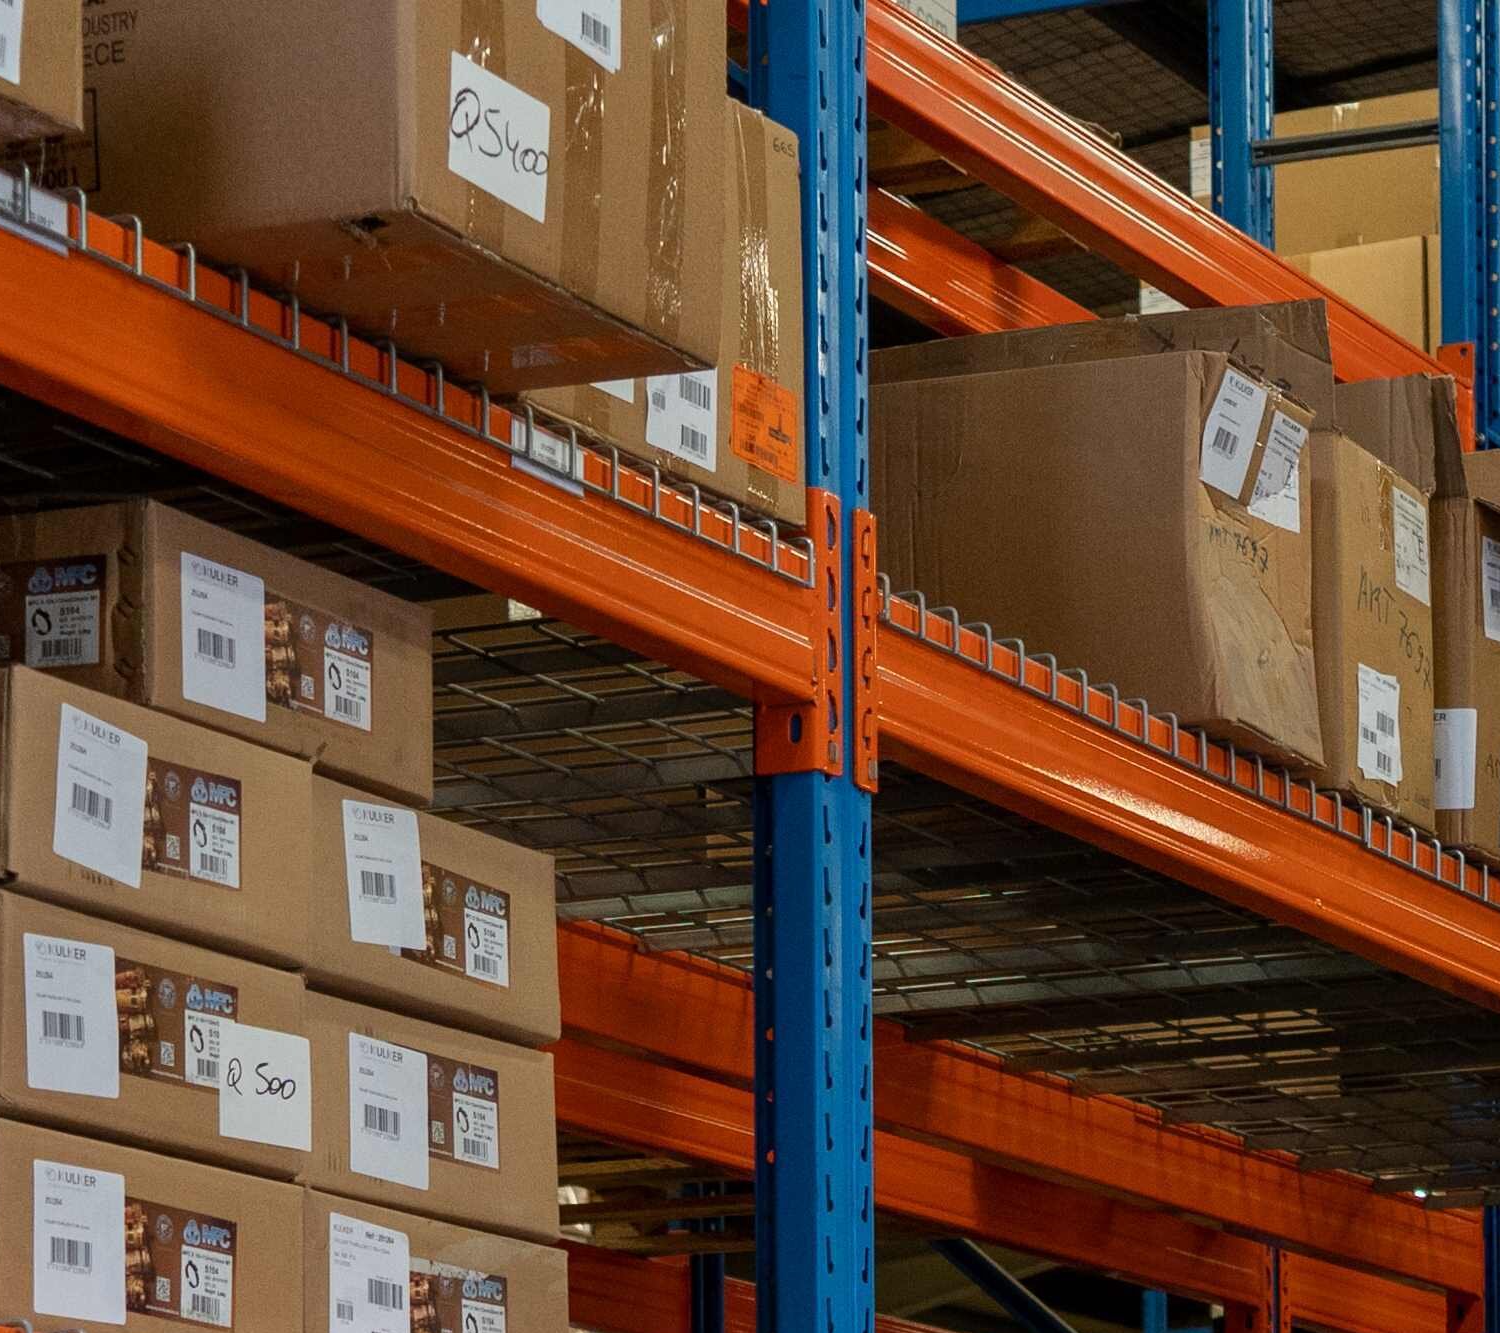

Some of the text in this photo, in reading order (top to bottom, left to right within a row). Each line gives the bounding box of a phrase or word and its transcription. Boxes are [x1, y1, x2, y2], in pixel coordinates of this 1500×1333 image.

[54, 564, 97, 586] MFC
[48, 944, 86, 961] KULKER
[255, 1062, 296, 1100] 500
[58, 1170, 96, 1188] KULKER
